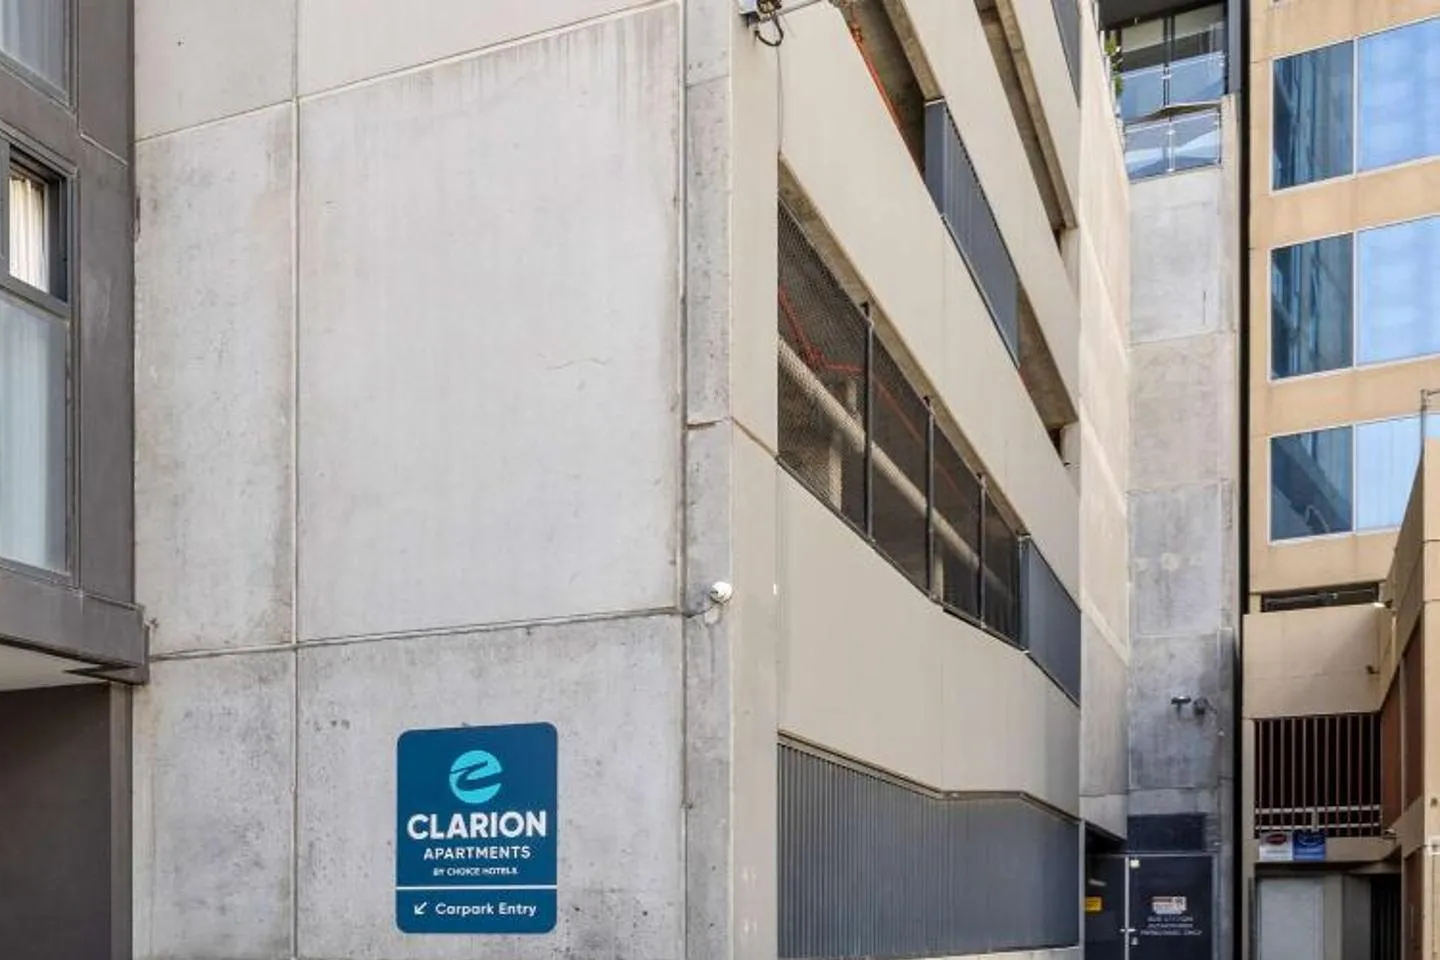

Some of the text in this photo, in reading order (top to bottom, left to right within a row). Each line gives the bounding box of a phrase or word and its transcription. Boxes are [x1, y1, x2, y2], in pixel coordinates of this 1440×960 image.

[407, 810, 546, 840] CLARION
[423, 845, 531, 861] APARTMENTS
[433, 866, 518, 877] BY CHOICE HOTELS
[435, 901, 537, 917] Carpark Entry
